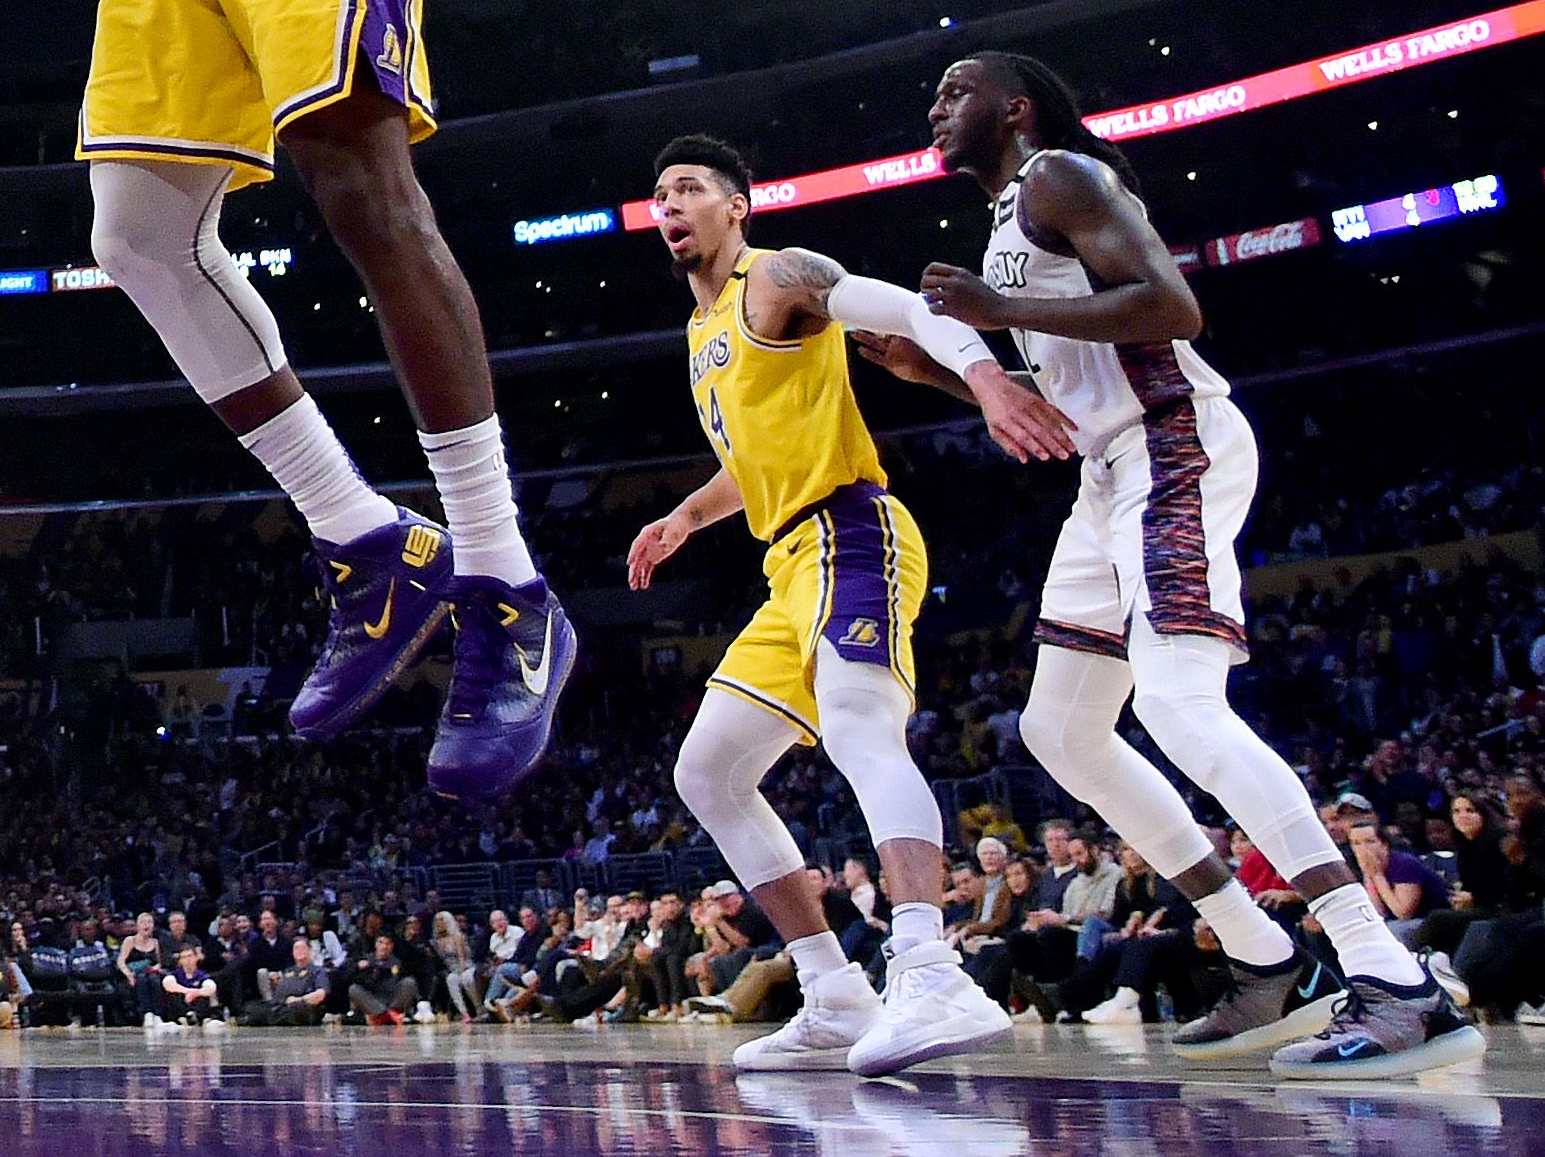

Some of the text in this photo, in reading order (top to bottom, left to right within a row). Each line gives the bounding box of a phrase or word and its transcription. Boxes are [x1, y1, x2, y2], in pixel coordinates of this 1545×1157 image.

[1319, 19, 1490, 81] WELLS FARGO
[1090, 84, 1247, 139] WELLS FARGO
[863, 151, 937, 186] WELLS
[513, 211, 609, 245] Spectrum
[55, 270, 114, 289] TOSH
